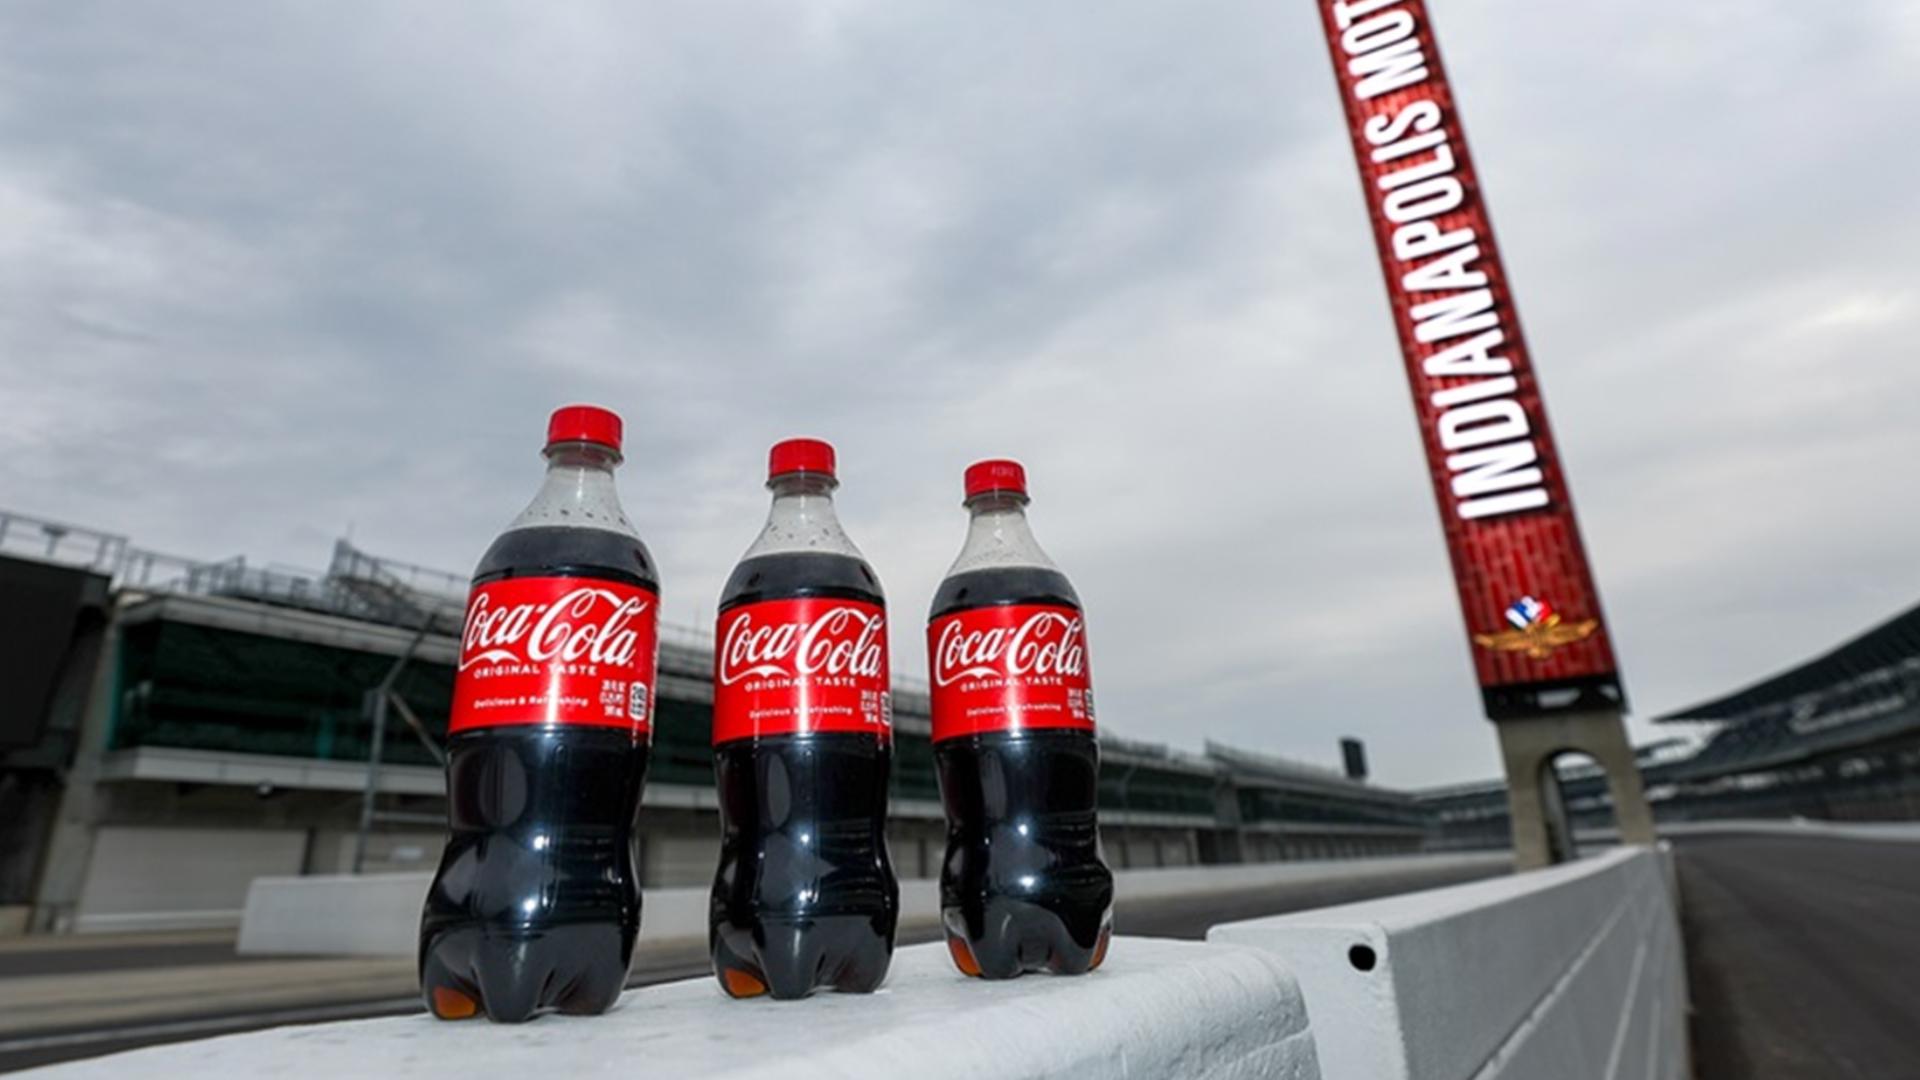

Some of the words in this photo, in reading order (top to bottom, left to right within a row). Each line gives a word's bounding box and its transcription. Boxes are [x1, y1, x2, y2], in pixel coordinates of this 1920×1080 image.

[1364, 99, 1549, 519] INDIANAPOLIS
[459, 587, 648, 672] Coca-Cola
[720, 607, 885, 685] Coca-Cola
[936, 612, 1083, 687] Coca-Cola
[474, 663, 540, 679] ORIGINAL
[548, 664, 597, 677] TASTE
[744, 677, 808, 692] ORIGINAL
[815, 676, 856, 687] TASTE
[961, 677, 1019, 692] ORIGINAL
[1025, 676, 1063, 686] TASTE
